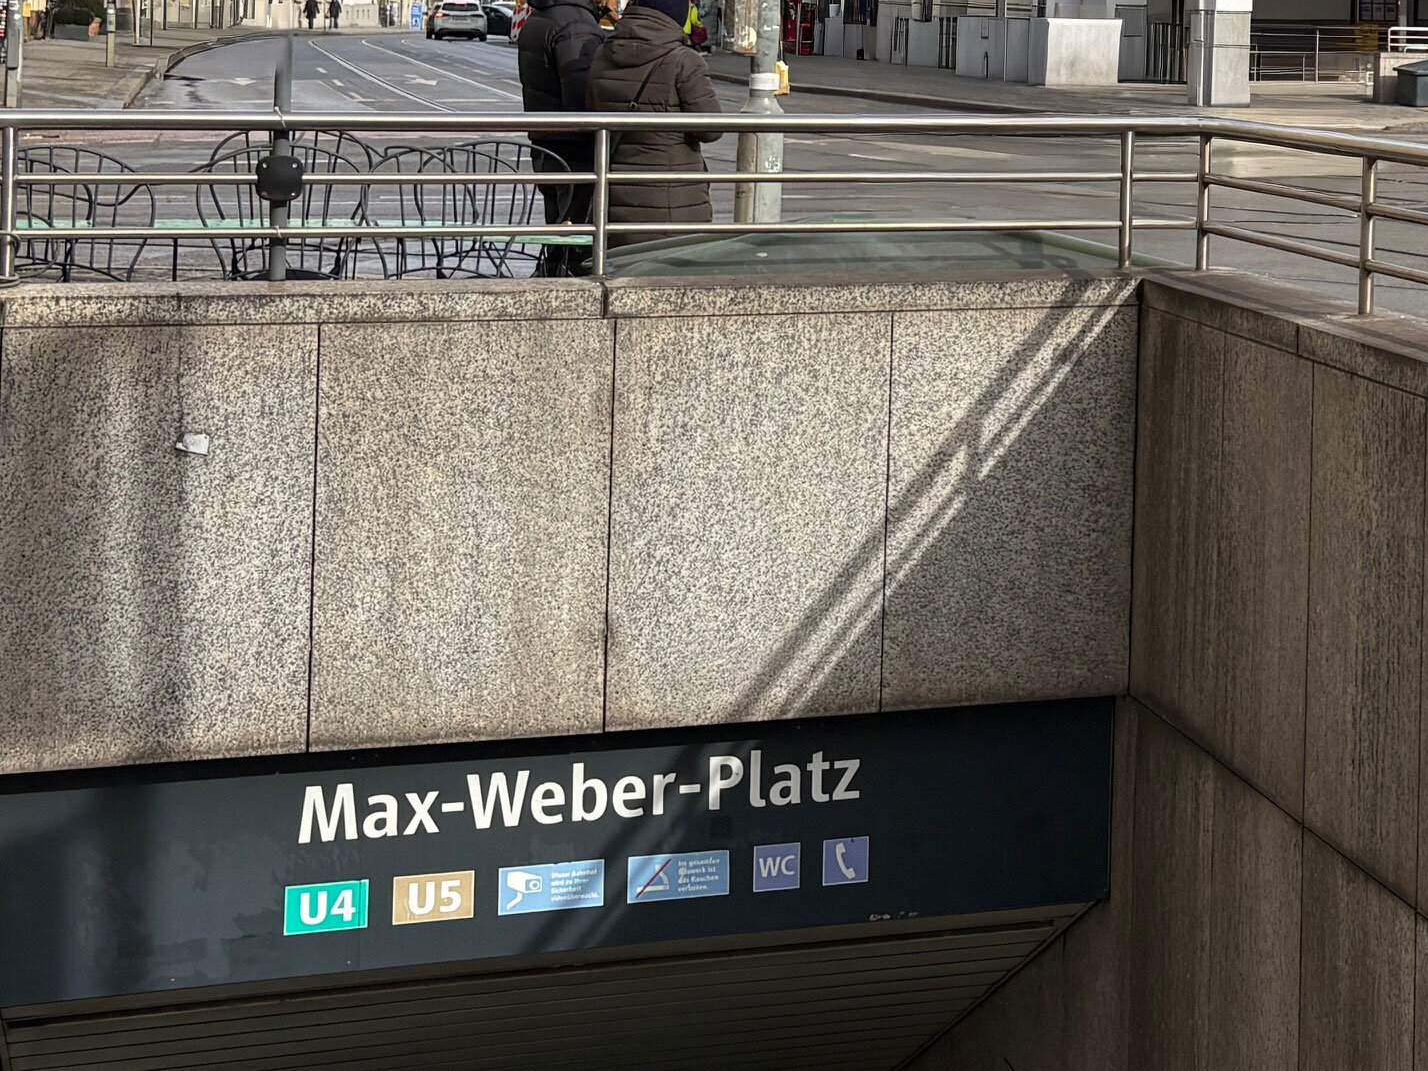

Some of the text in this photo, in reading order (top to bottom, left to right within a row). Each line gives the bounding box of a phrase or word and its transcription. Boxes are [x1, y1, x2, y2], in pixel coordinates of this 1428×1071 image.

[299, 750, 861, 844] Max-Weber-Platz
[678, 874, 719, 884] das Rauchen
[759, 855, 795, 877] WC
[408, 880, 462, 915] U5
[551, 885, 582, 894] Sicherheit
[300, 888, 356, 924] U4
